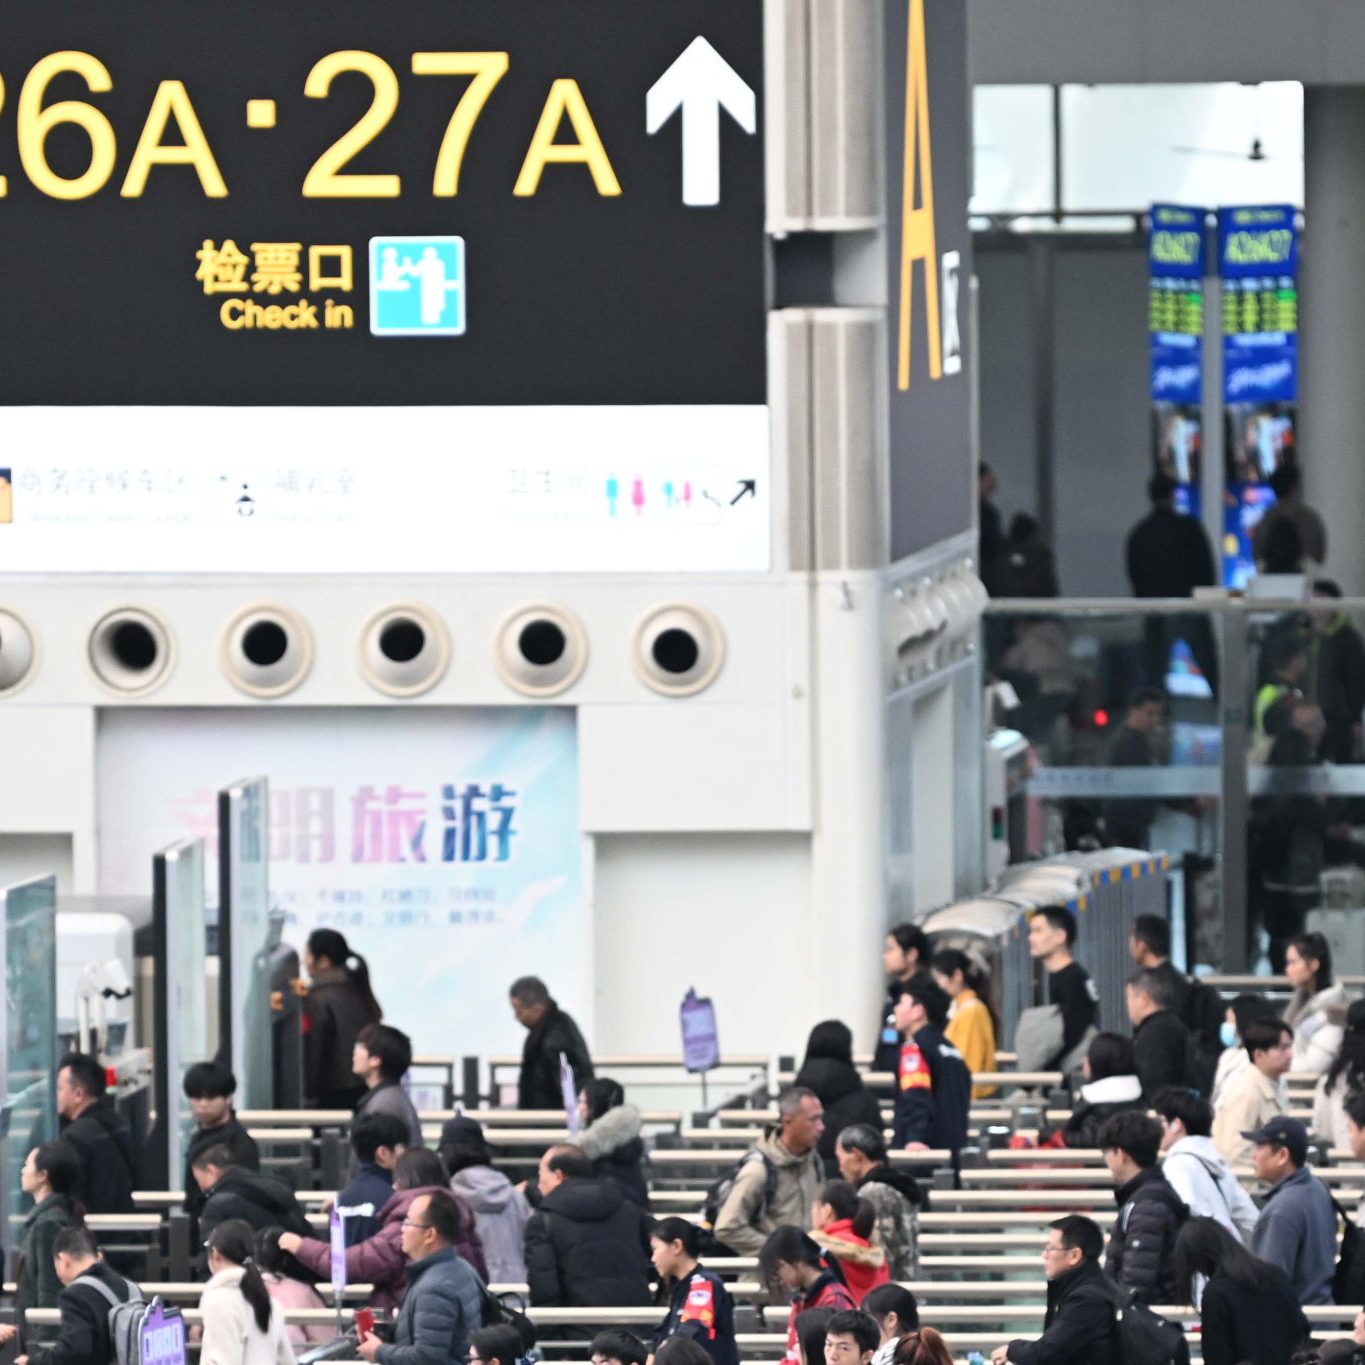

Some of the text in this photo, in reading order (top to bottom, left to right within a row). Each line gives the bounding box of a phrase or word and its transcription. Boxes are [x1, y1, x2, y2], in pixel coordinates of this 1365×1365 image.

[196, 239, 354, 294] 检票口
[220, 297, 354, 330] Check in
